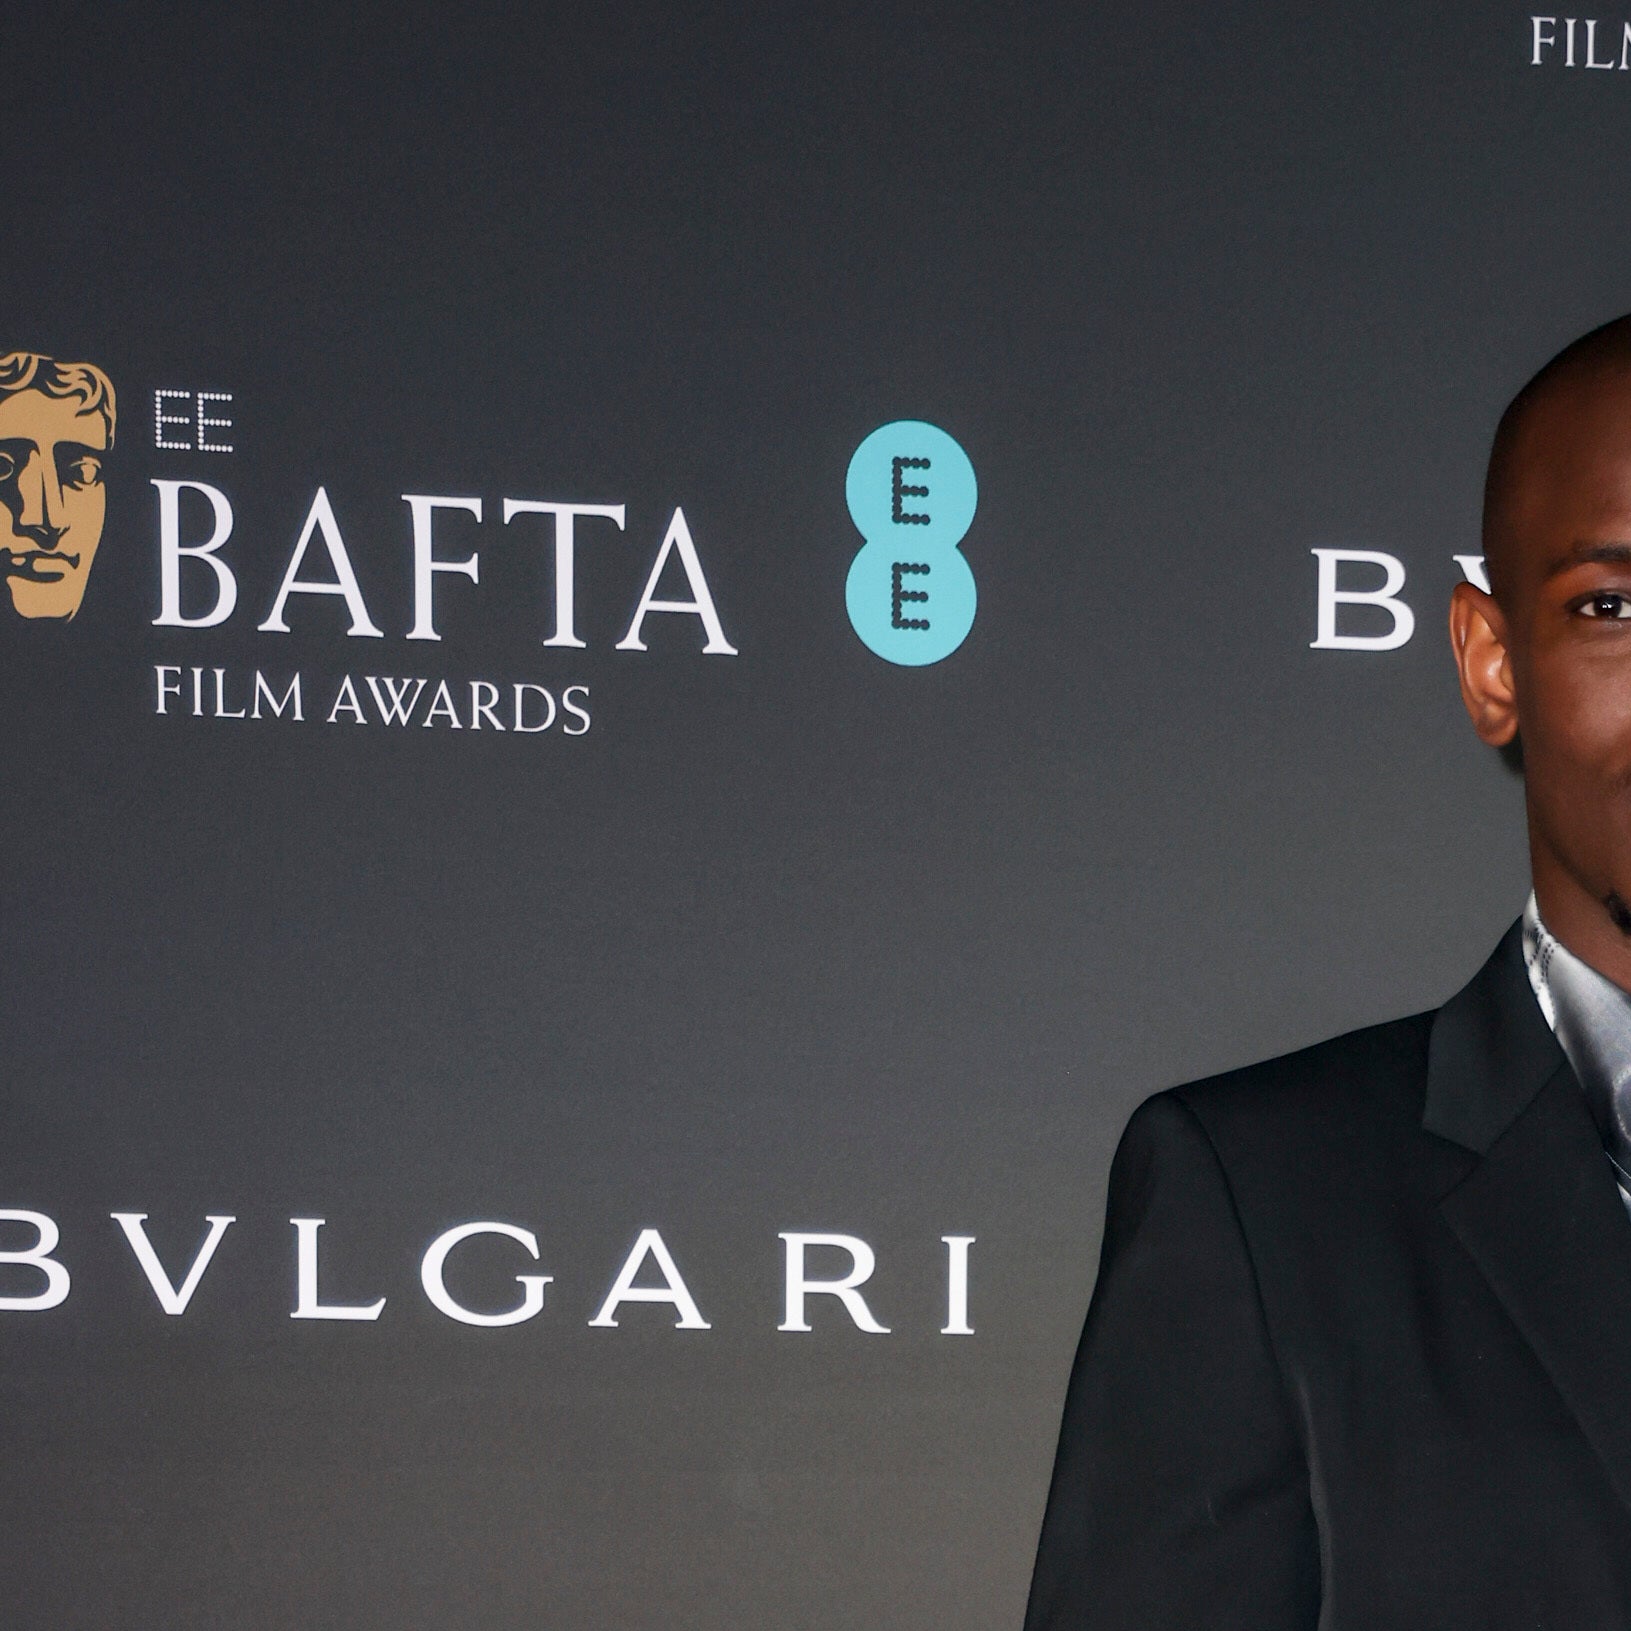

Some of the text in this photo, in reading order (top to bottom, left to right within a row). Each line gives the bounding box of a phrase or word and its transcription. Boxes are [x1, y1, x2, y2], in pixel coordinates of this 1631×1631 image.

[155, 390, 233, 452] EE
[151, 479, 738, 655] BAFTA
[155, 666, 590, 734] FILM AWARDS
[0, 1210, 975, 1334] BVLGARI
